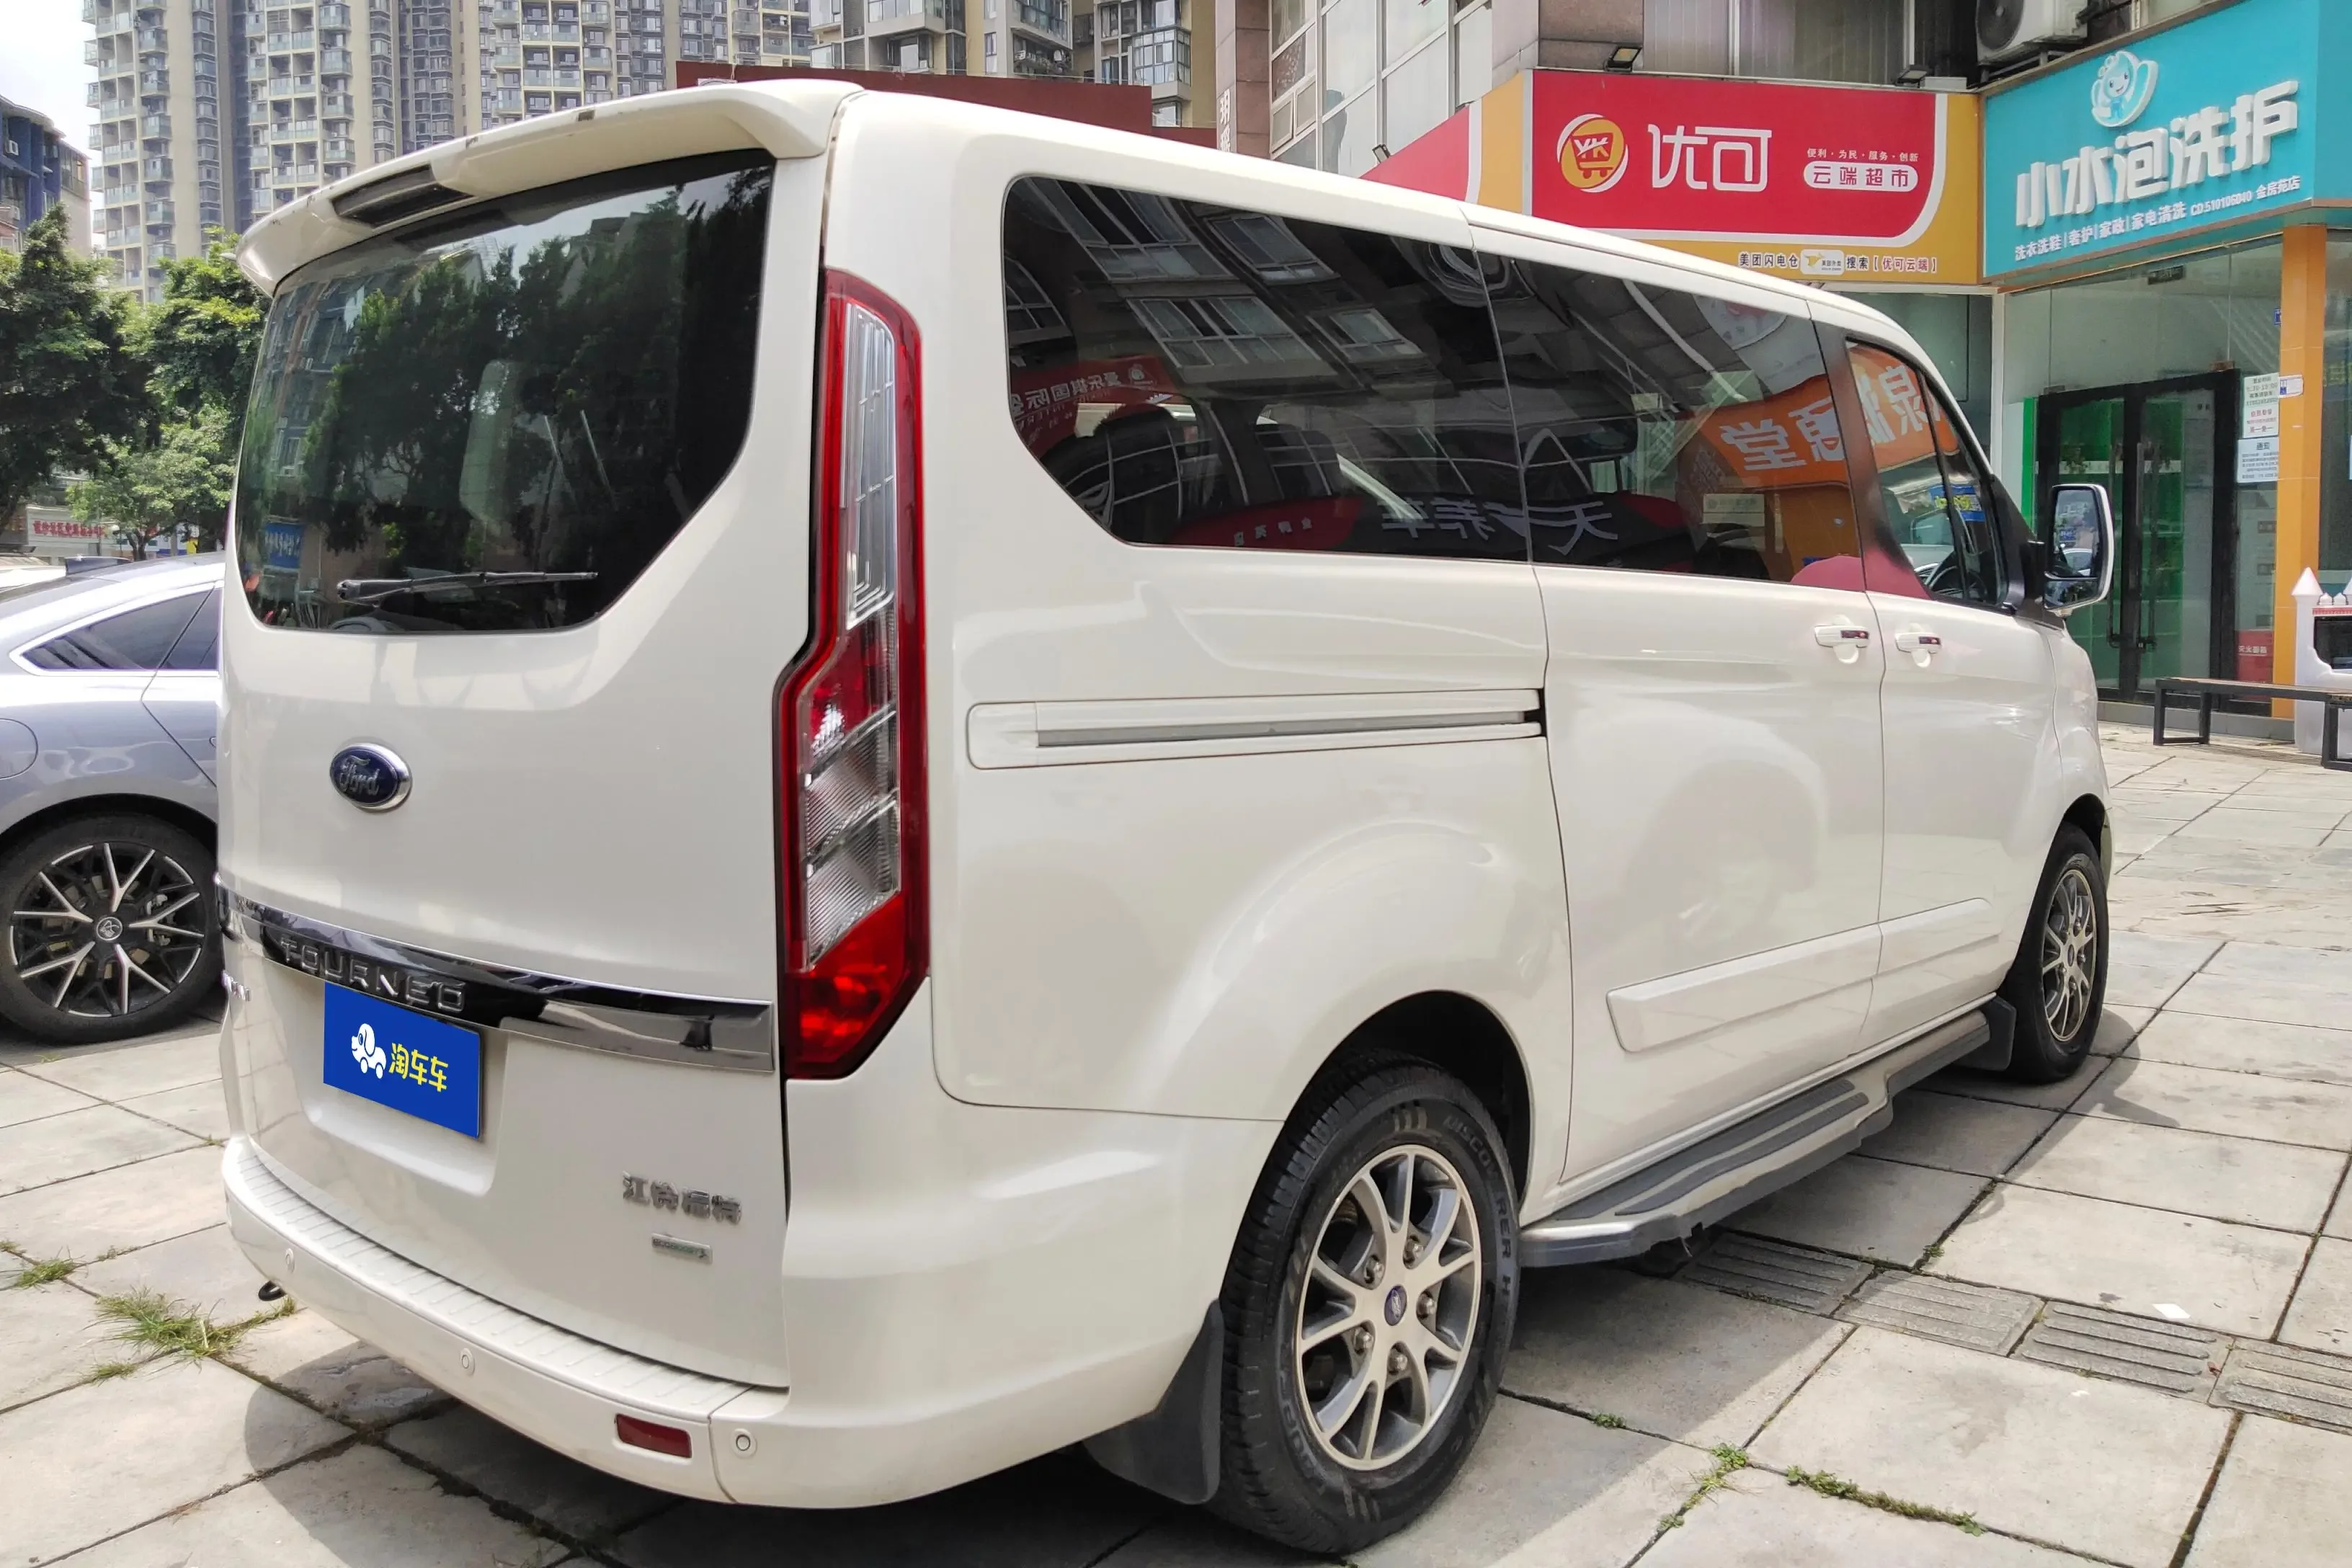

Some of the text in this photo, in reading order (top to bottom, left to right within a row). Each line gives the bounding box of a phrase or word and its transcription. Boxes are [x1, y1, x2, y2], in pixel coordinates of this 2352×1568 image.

[1647, 123, 1773, 193] 优可
[1813, 166, 1909, 187] 云端超市
[1739, 253, 1799, 267] 美团闪电仓
